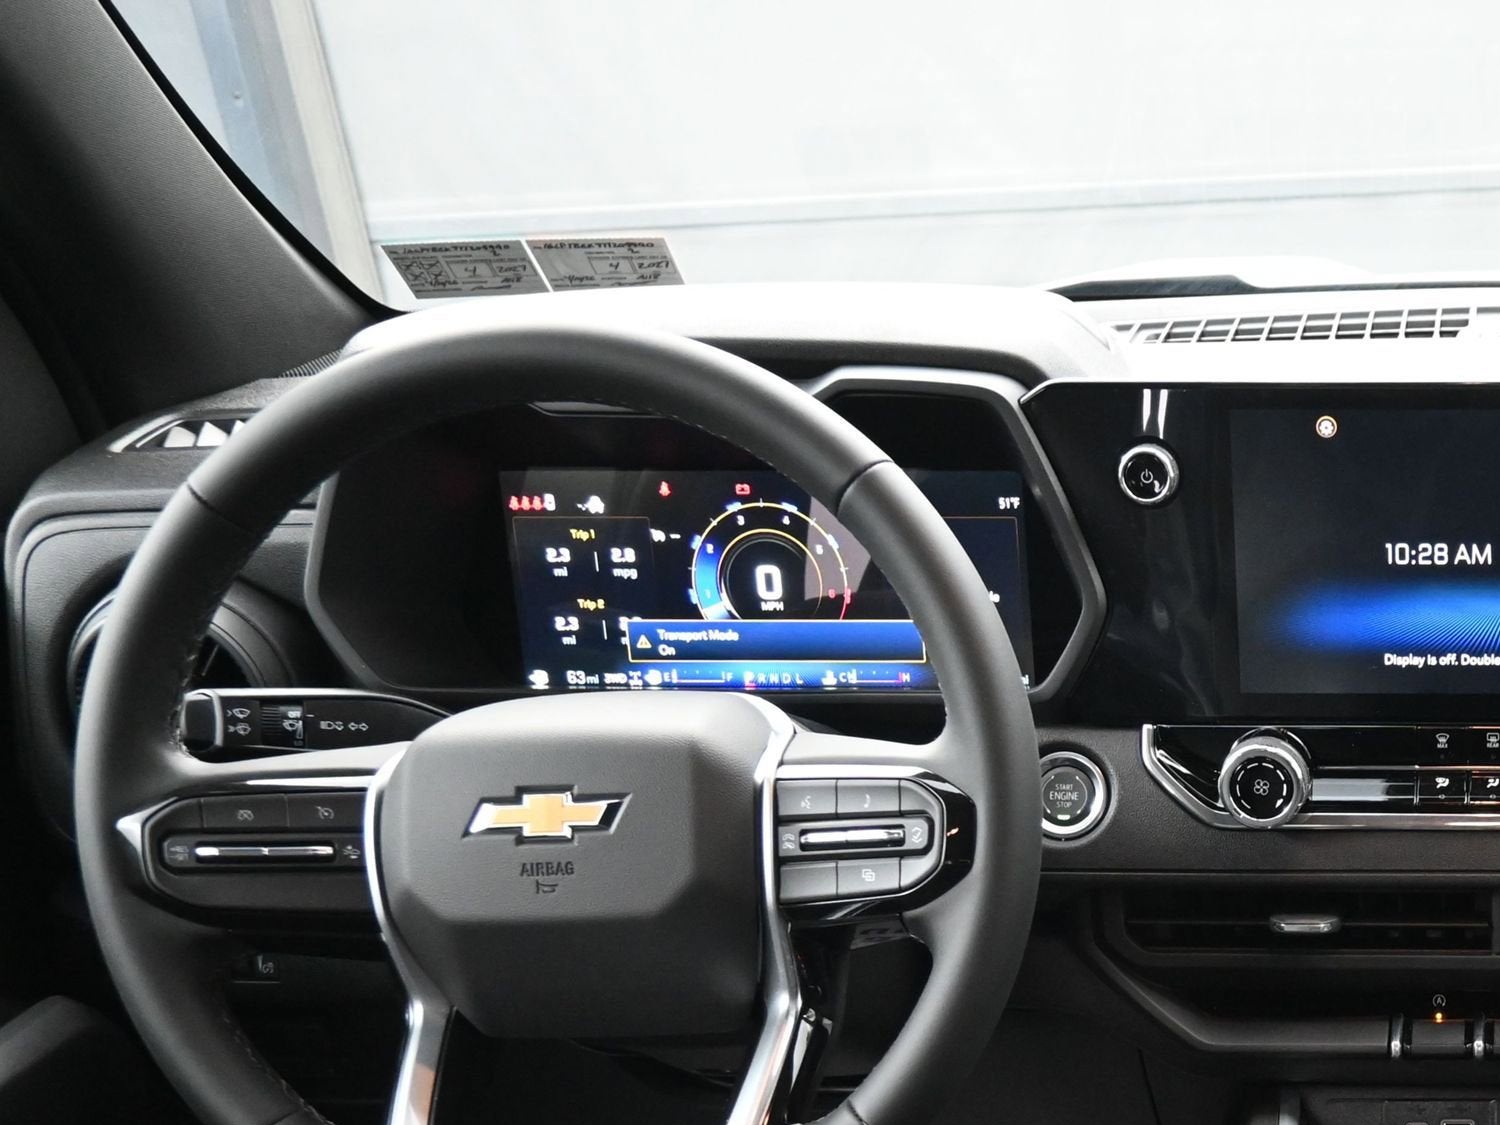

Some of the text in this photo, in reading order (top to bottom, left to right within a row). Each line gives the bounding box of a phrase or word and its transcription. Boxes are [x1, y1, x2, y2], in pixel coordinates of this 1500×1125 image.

[570, 529, 590, 541] Trip
[1385, 543, 1492, 566] 10:28 AM
[612, 567, 638, 580] mpg
[755, 564, 783, 601] 0
[577, 599, 597, 611] Trip
[761, 601, 784, 612] MPH
[656, 629, 739, 643] Transport Mode
[658, 644, 676, 656] On
[1384, 653, 1425, 668] Display
[1427, 653, 1437, 666] is
[1438, 653, 1459, 666] off.
[1460, 653, 1500, 666] Double
[1055, 783, 1073, 791] START
[1049, 791, 1080, 801] ENGINE
[520, 861, 575, 877] AIRBAG
